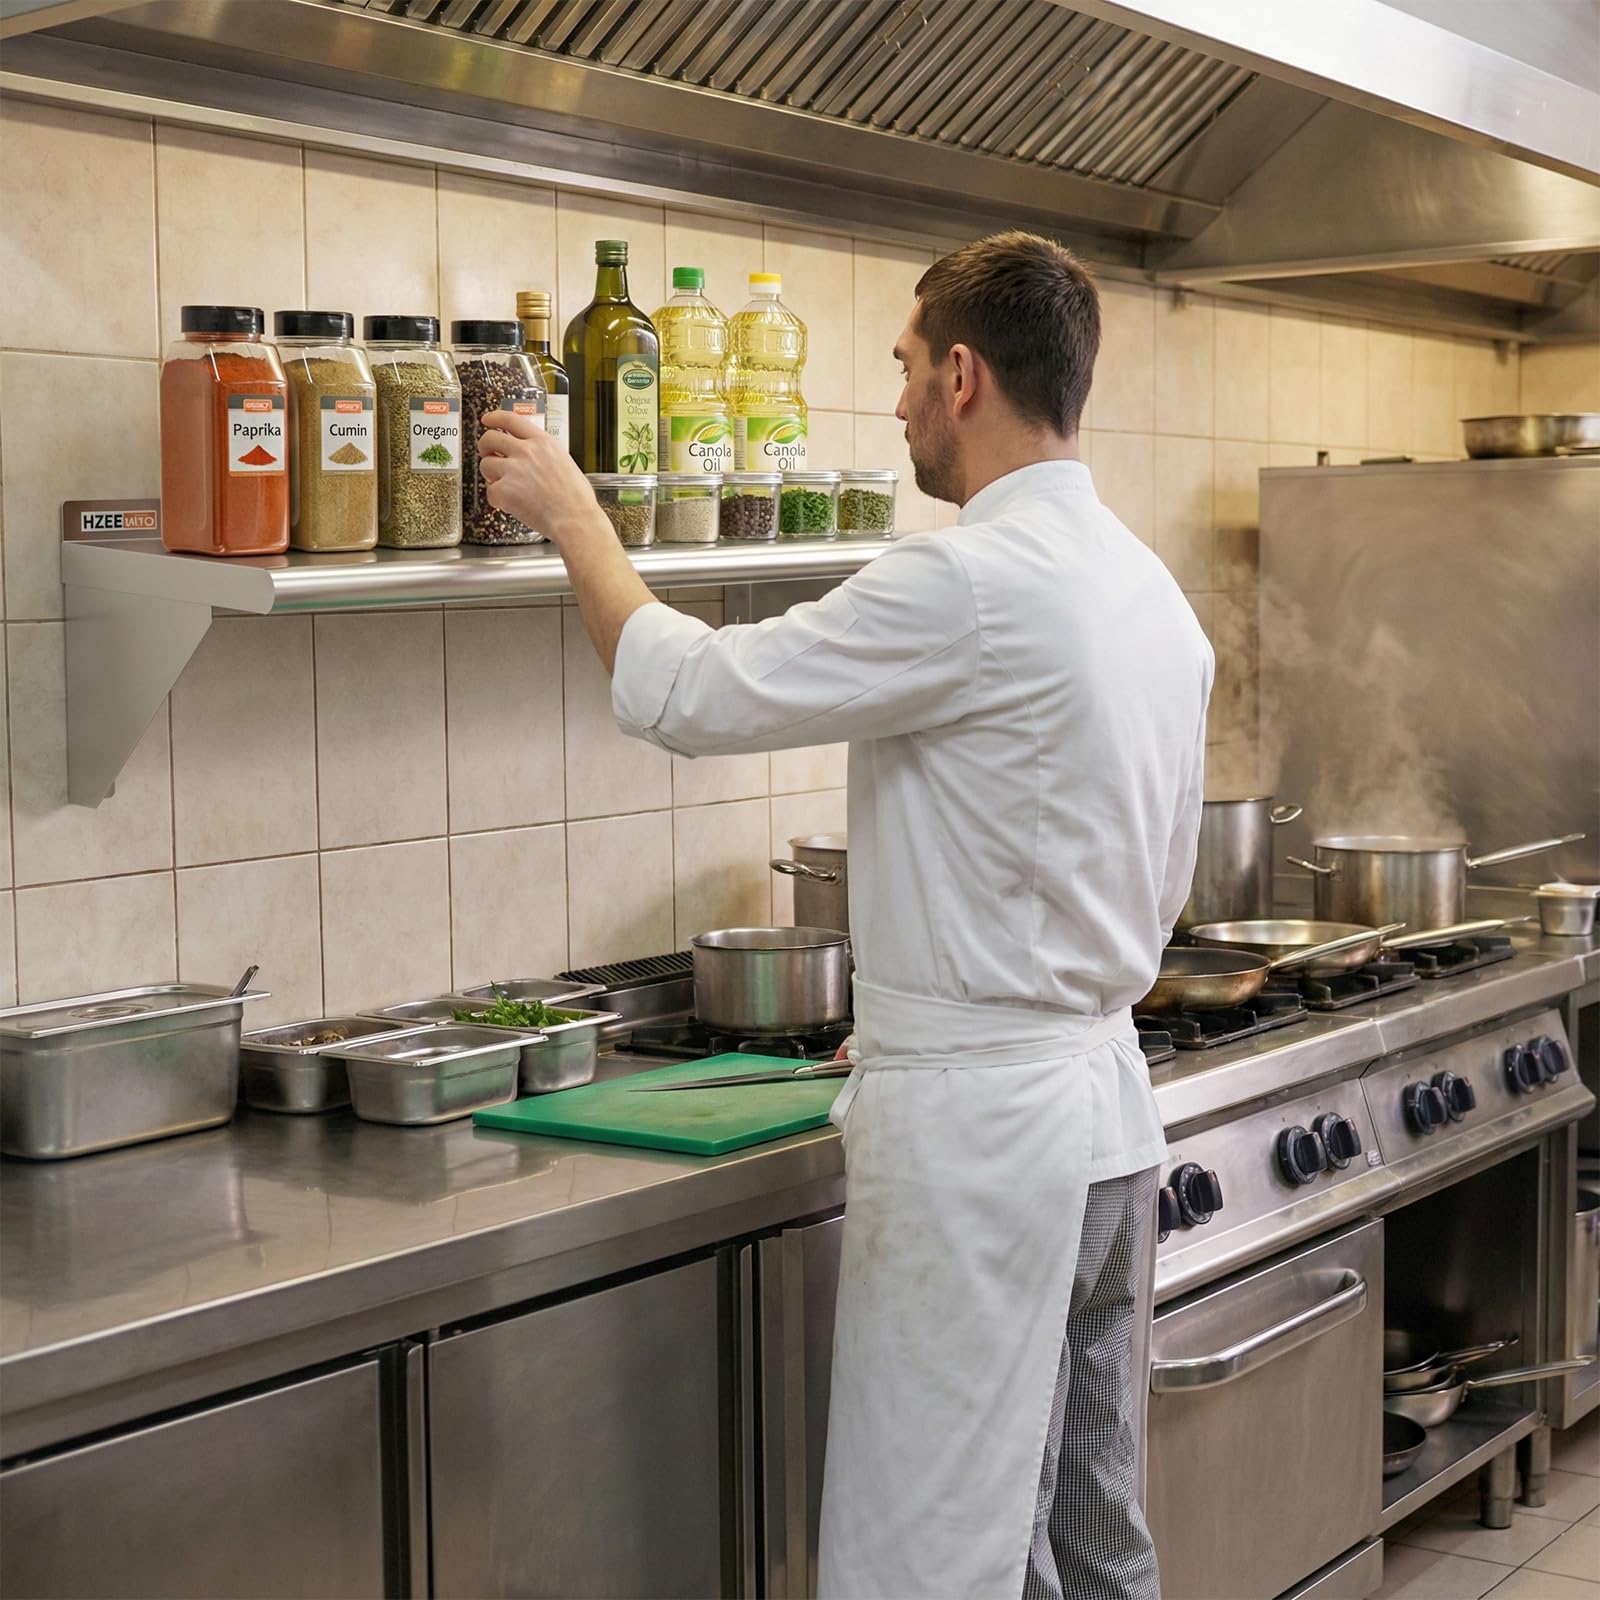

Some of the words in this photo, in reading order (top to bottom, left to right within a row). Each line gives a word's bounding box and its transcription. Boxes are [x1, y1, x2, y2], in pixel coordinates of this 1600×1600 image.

[233, 422, 281, 440] Paprika
[329, 423, 367, 436] Cumin
[412, 423, 458, 440] Oregano
[688, 443, 732, 458] Canola
[763, 442, 806, 457] Canola
[703, 457, 721, 472] Oil
[778, 457, 796, 471] Oil
